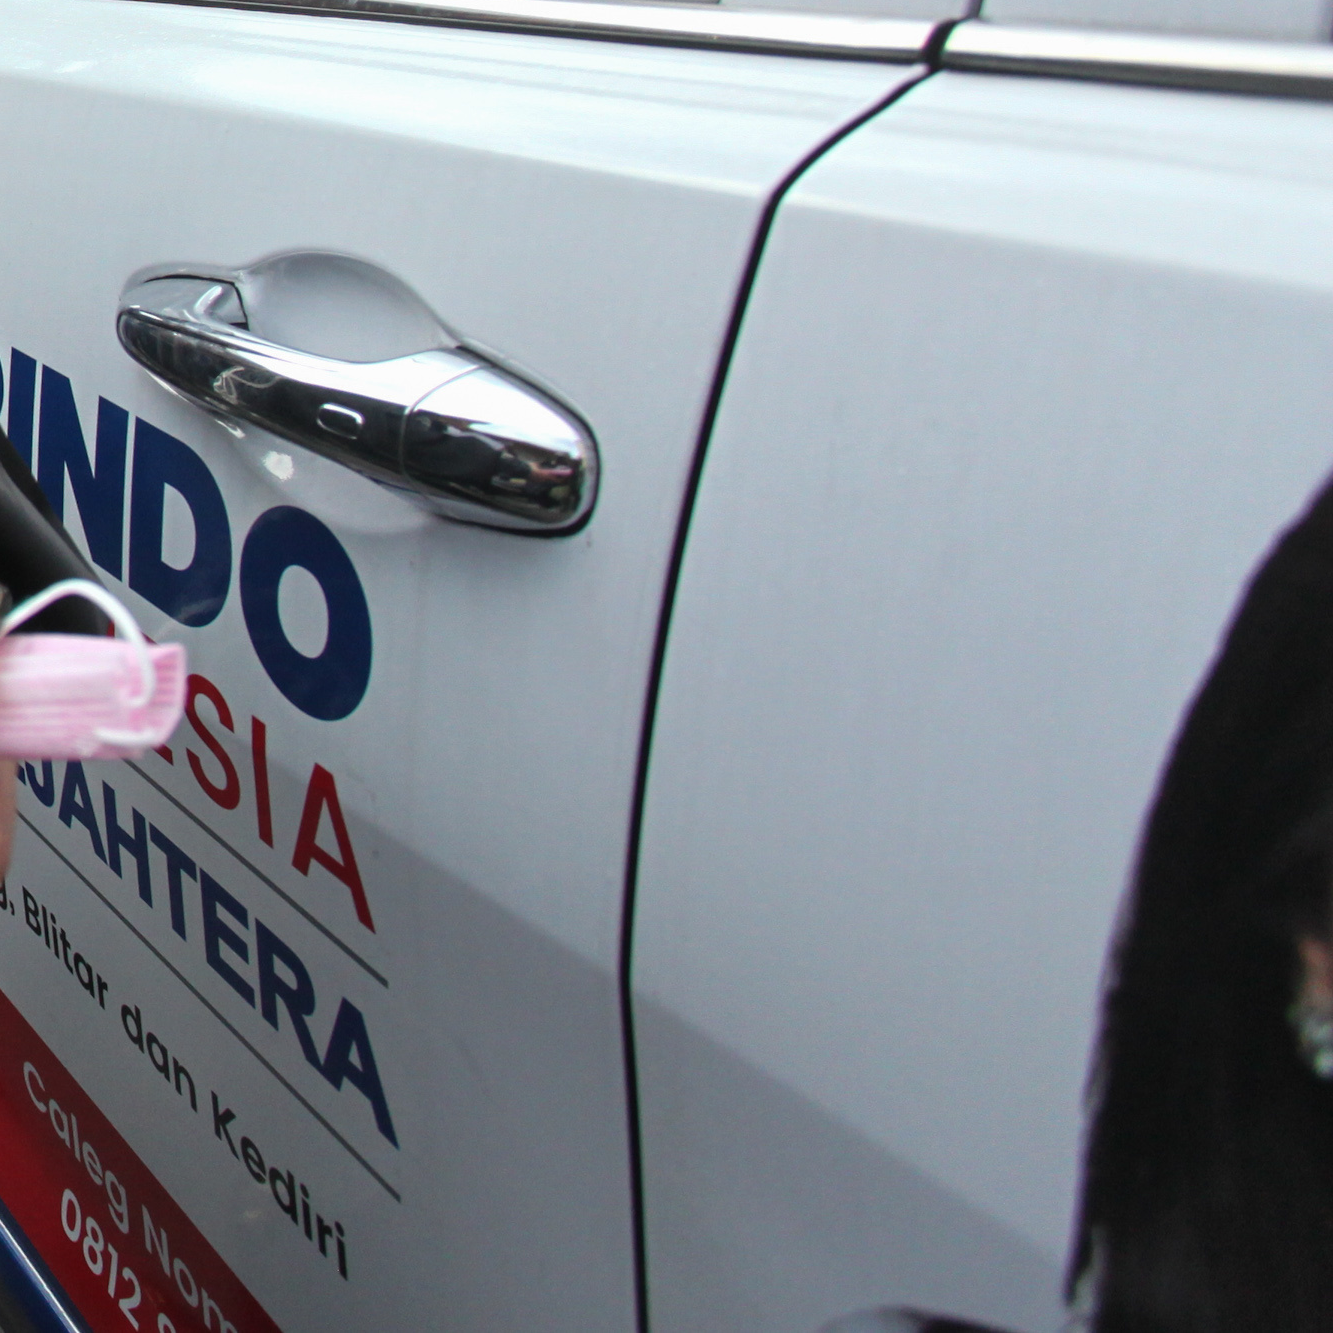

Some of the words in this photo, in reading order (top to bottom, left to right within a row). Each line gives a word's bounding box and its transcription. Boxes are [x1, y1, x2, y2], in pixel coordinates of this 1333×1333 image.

[143, 632, 375, 934] SIA
[17, 758, 400, 1151] JAHTERA
[22, 885, 108, 1010] Blitar
[121, 1004, 197, 1113] dan
[211, 1090, 347, 1281] Kediri
[23, 1061, 129, 1234] Caleg
[61, 1188, 141, 1331] 0812
